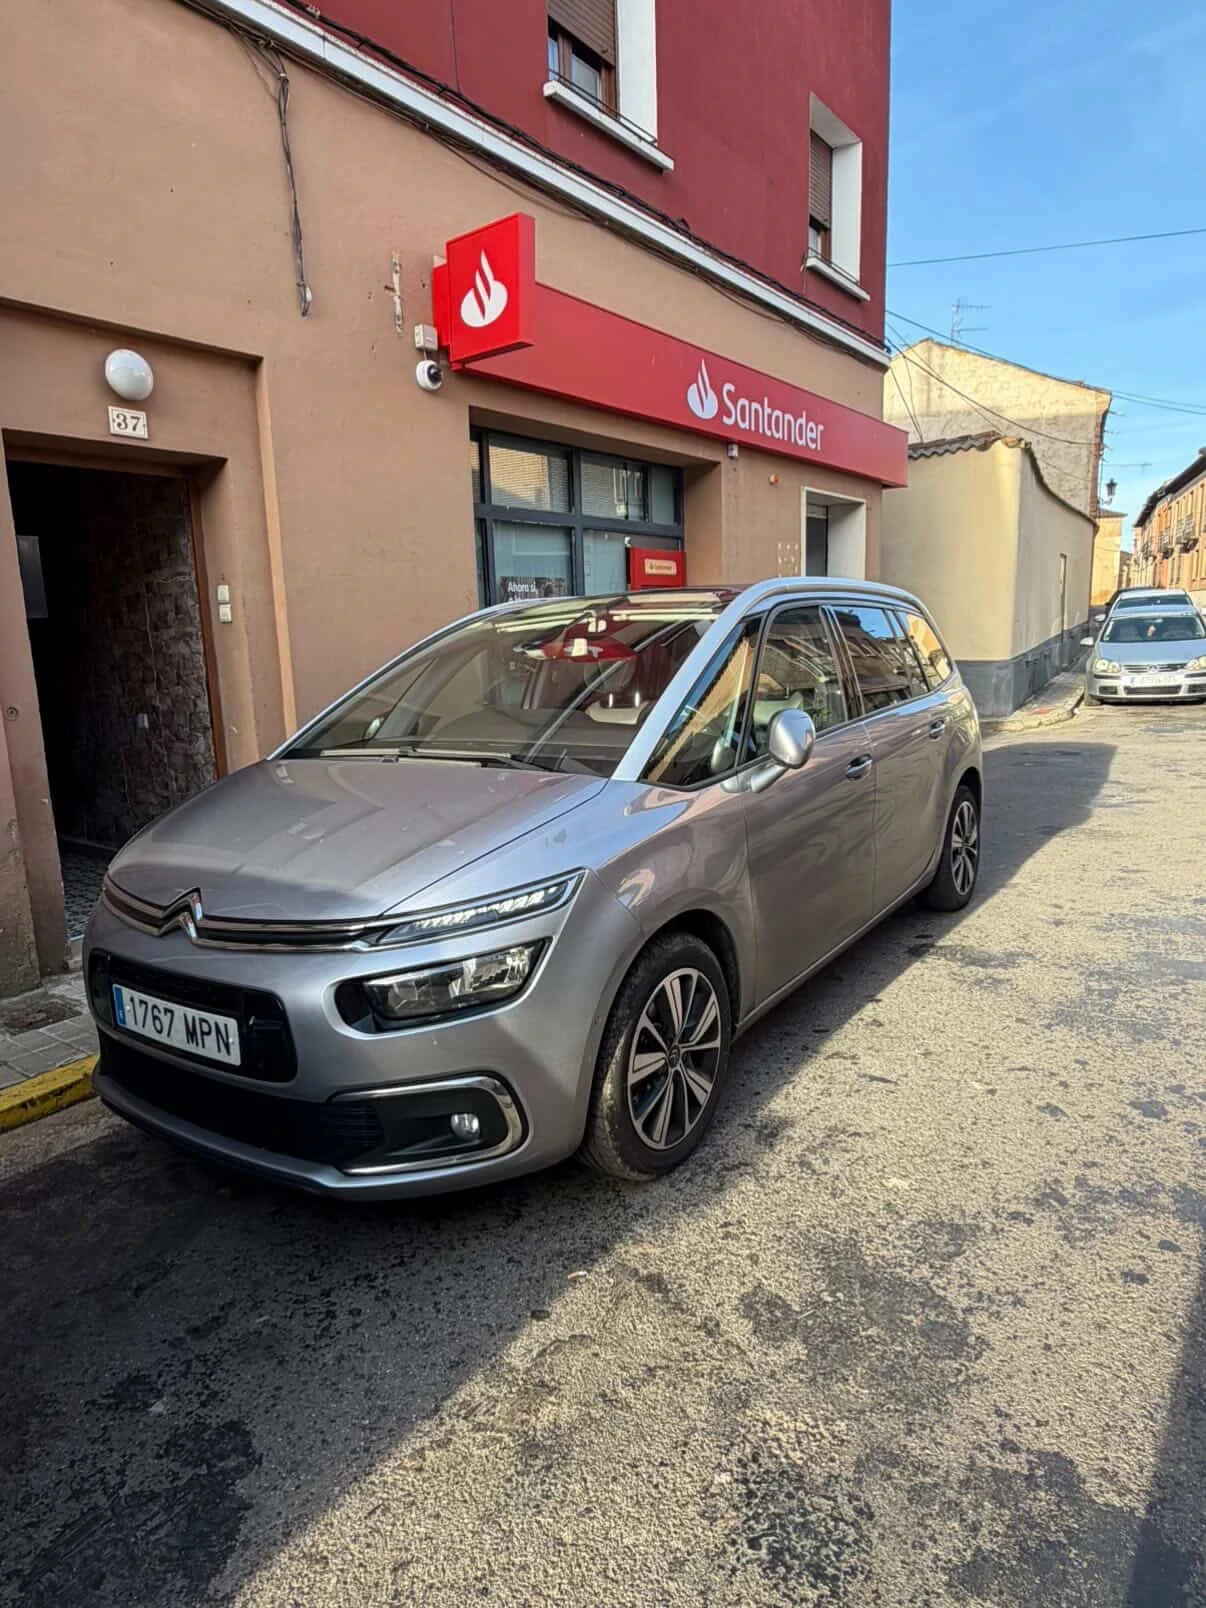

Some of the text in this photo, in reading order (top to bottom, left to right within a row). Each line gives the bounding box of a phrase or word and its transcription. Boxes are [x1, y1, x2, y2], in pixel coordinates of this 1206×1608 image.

[116, 413, 141, 432] 37
[722, 382, 825, 451] Santander
[129, 996, 231, 1056] 1767 MPN
